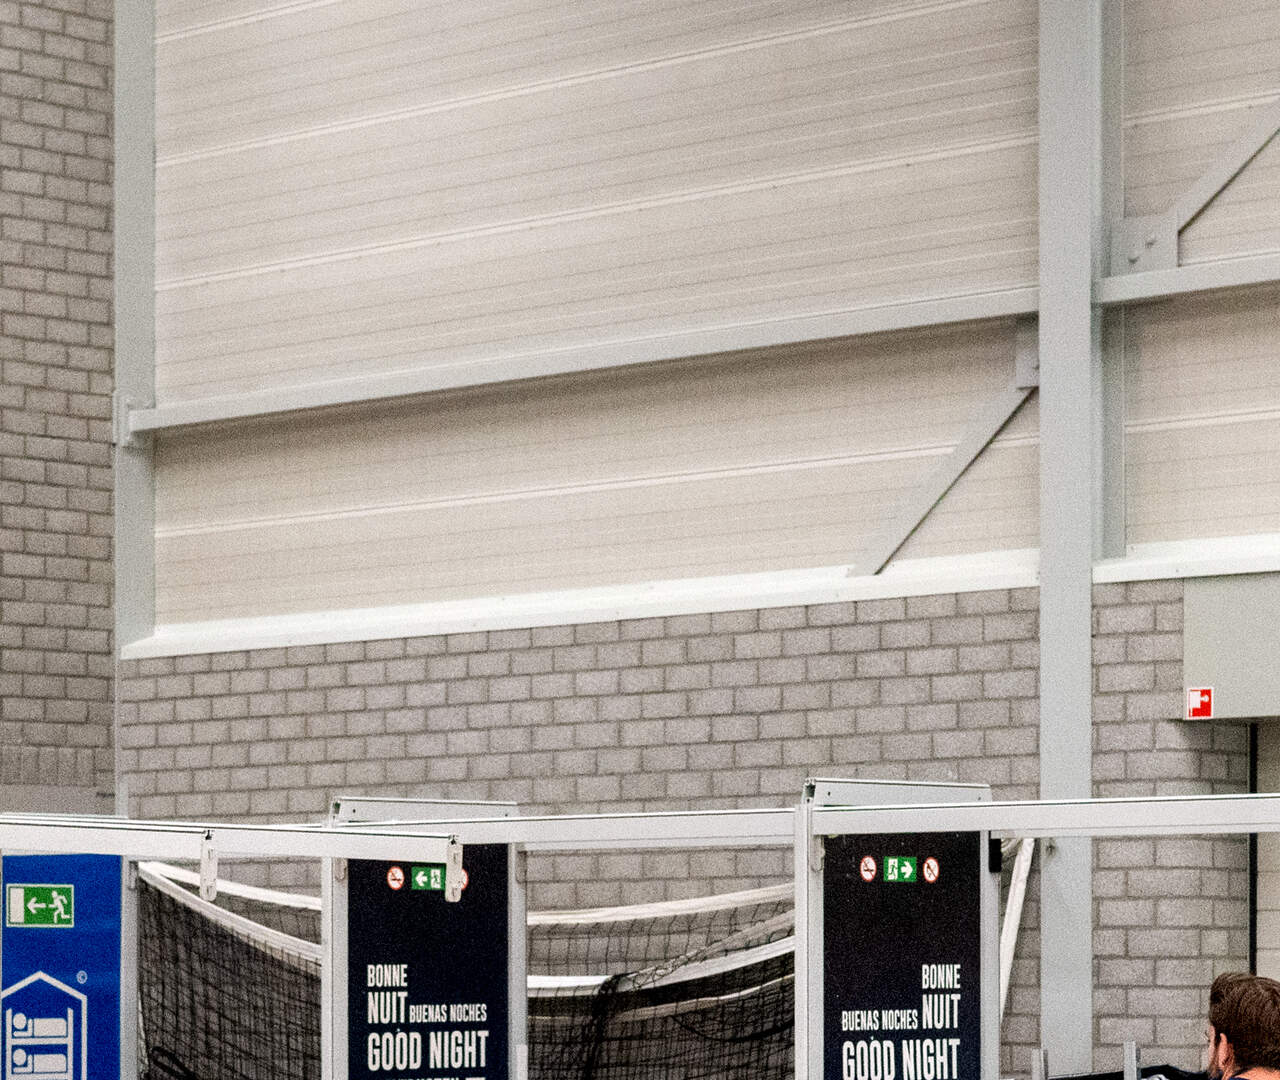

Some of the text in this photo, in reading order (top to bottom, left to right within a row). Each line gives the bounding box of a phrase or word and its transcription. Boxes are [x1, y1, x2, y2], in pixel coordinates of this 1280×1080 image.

[368, 964, 408, 987] BONNE
[922, 964, 961, 989] BONNE
[368, 992, 408, 1024] NUIT
[409, 1004, 487, 1023] BUENAS NOCHES
[842, 1009, 918, 1031] BUENAS NOCHES
[922, 994, 961, 1029] NUIT
[368, 1030, 489, 1071] GOOD NIGHT
[902, 1038, 960, 1080] NIGHT
